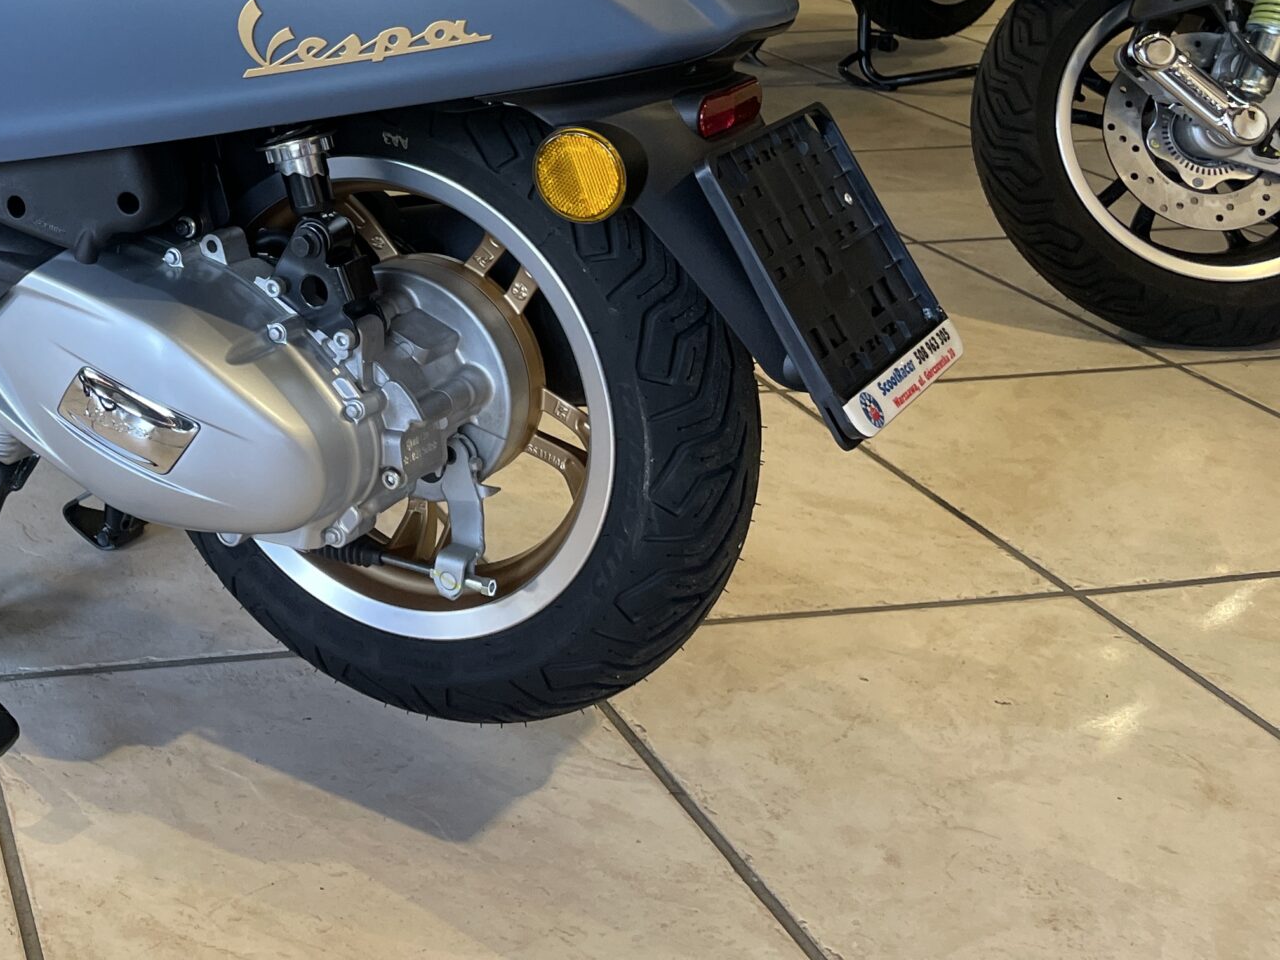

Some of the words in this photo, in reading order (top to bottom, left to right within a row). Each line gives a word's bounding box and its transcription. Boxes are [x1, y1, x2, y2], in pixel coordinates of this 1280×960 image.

[913, 346, 929, 365] 508
[925, 336, 940, 354] 963
[936, 327, 951, 345] 305
